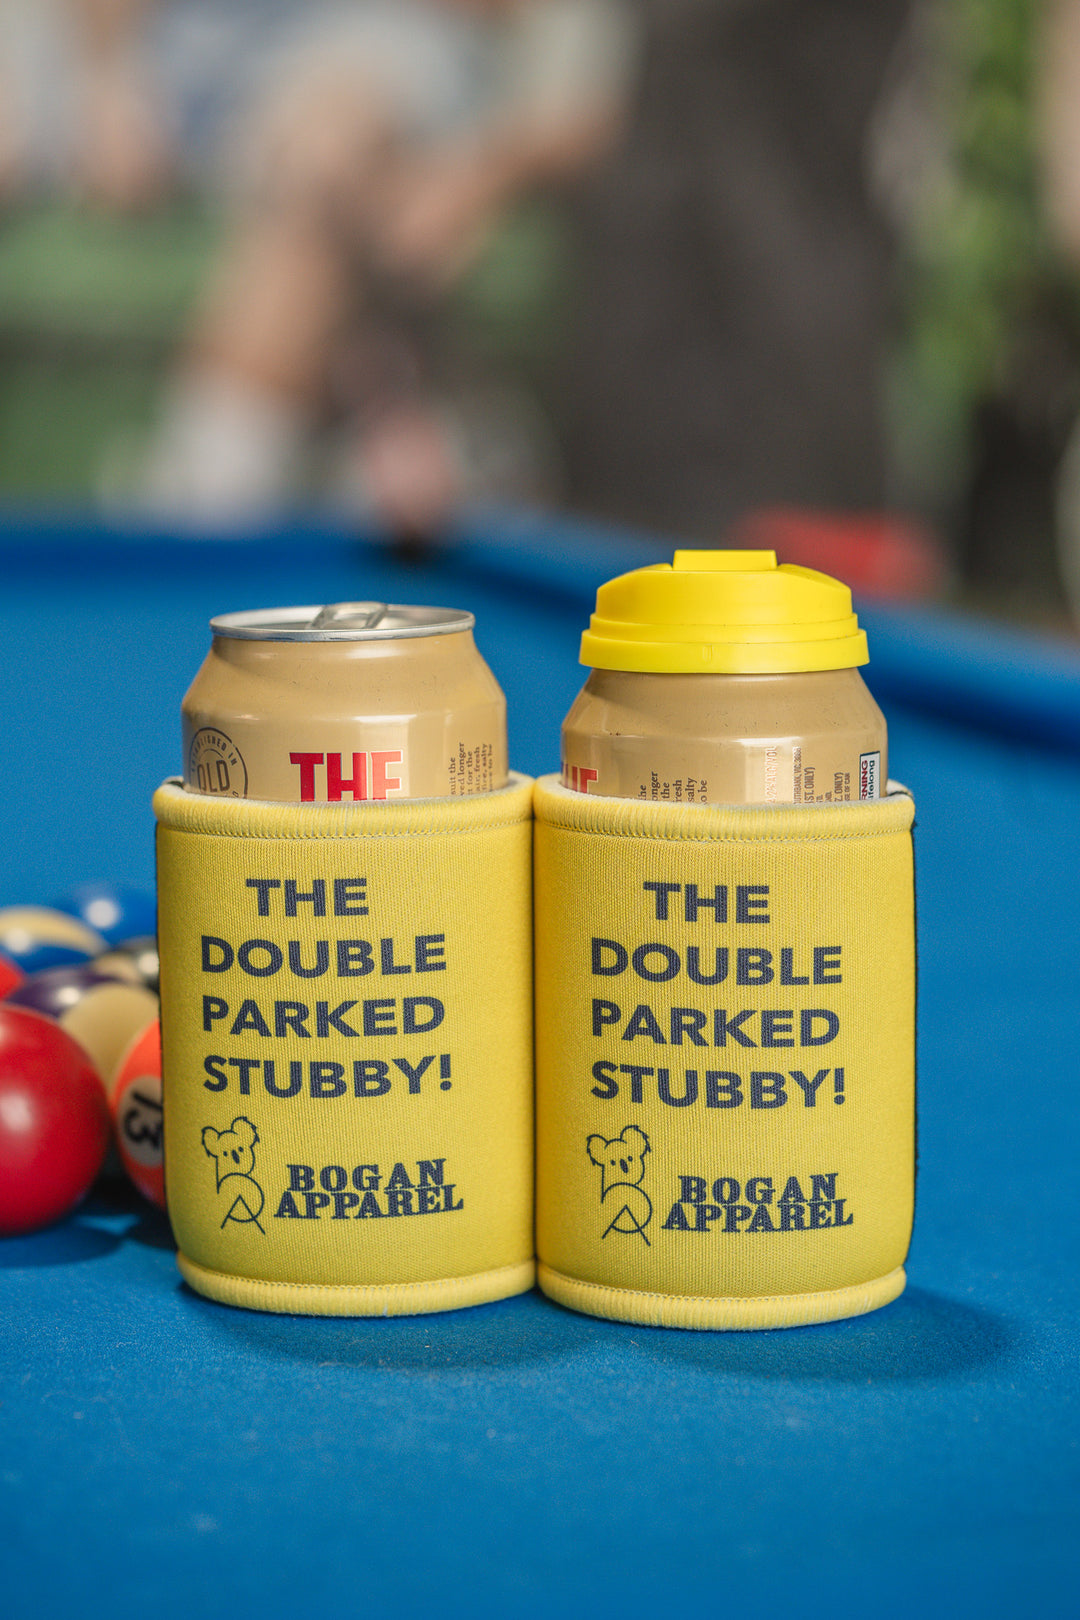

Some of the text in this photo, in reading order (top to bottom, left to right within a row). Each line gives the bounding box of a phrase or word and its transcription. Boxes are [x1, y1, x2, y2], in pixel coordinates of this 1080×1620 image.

[448, 757, 456, 773] the
[457, 742, 466, 775] longer
[197, 760, 230, 792] OLD
[661, 782, 670, 799] the
[685, 777, 697, 802] salty
[698, 779, 707, 792] be
[804, 767, 815, 789] ONLY)
[834, 772, 844, 793] ONLY)
[246, 878, 369, 917] THE
[643, 881, 770, 924] THE
[201, 934, 446, 978] DOUBLE
[591, 937, 843, 986] DOUBLE
[202, 995, 445, 1038] PARKED
[591, 998, 840, 1048] PARKED
[203, 1054, 452, 1098] STUBBY!
[590, 1060, 845, 1109] STUBBY!
[287, 1158, 446, 1192] BOGAN
[678, 1173, 838, 1205] BOGAN
[273, 1184, 464, 1220] APPAREL
[661, 1199, 853, 1233] APPAREL
